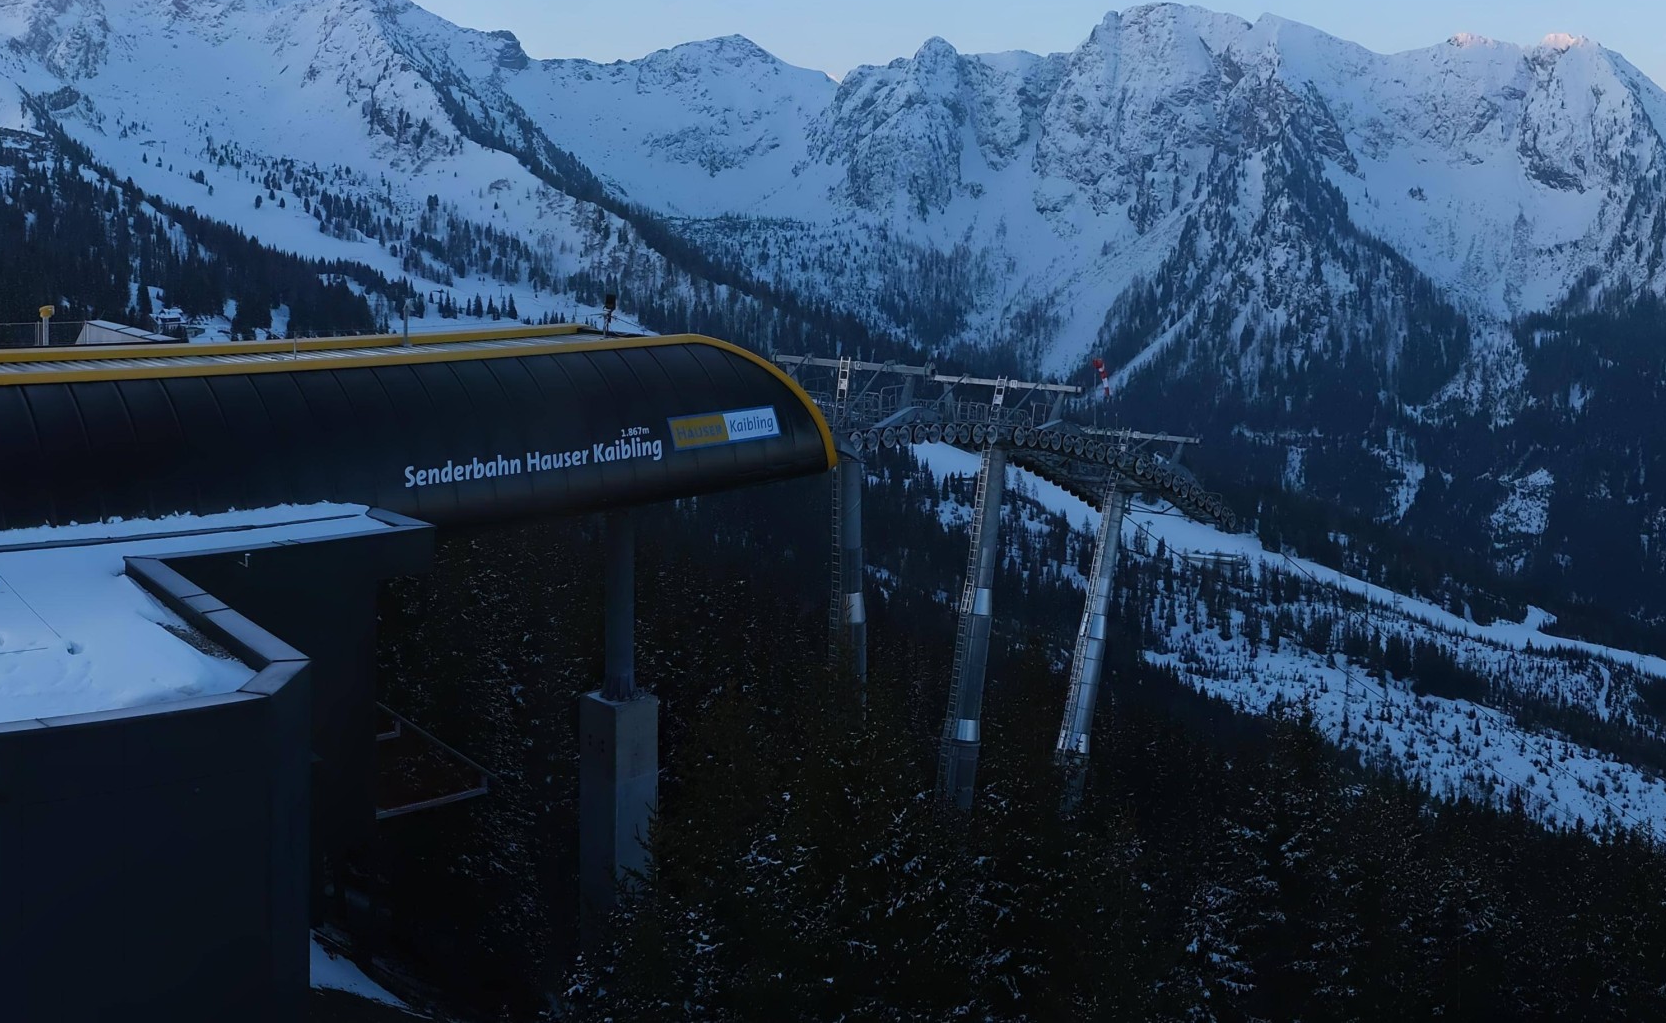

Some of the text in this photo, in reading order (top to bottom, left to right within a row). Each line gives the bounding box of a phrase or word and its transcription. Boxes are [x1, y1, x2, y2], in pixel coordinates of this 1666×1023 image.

[621, 426, 650, 438] 1.867m
[676, 417, 774, 441] HAUSER Kaibling
[404, 436, 663, 488] Senderbahn Hauser Kaibling
